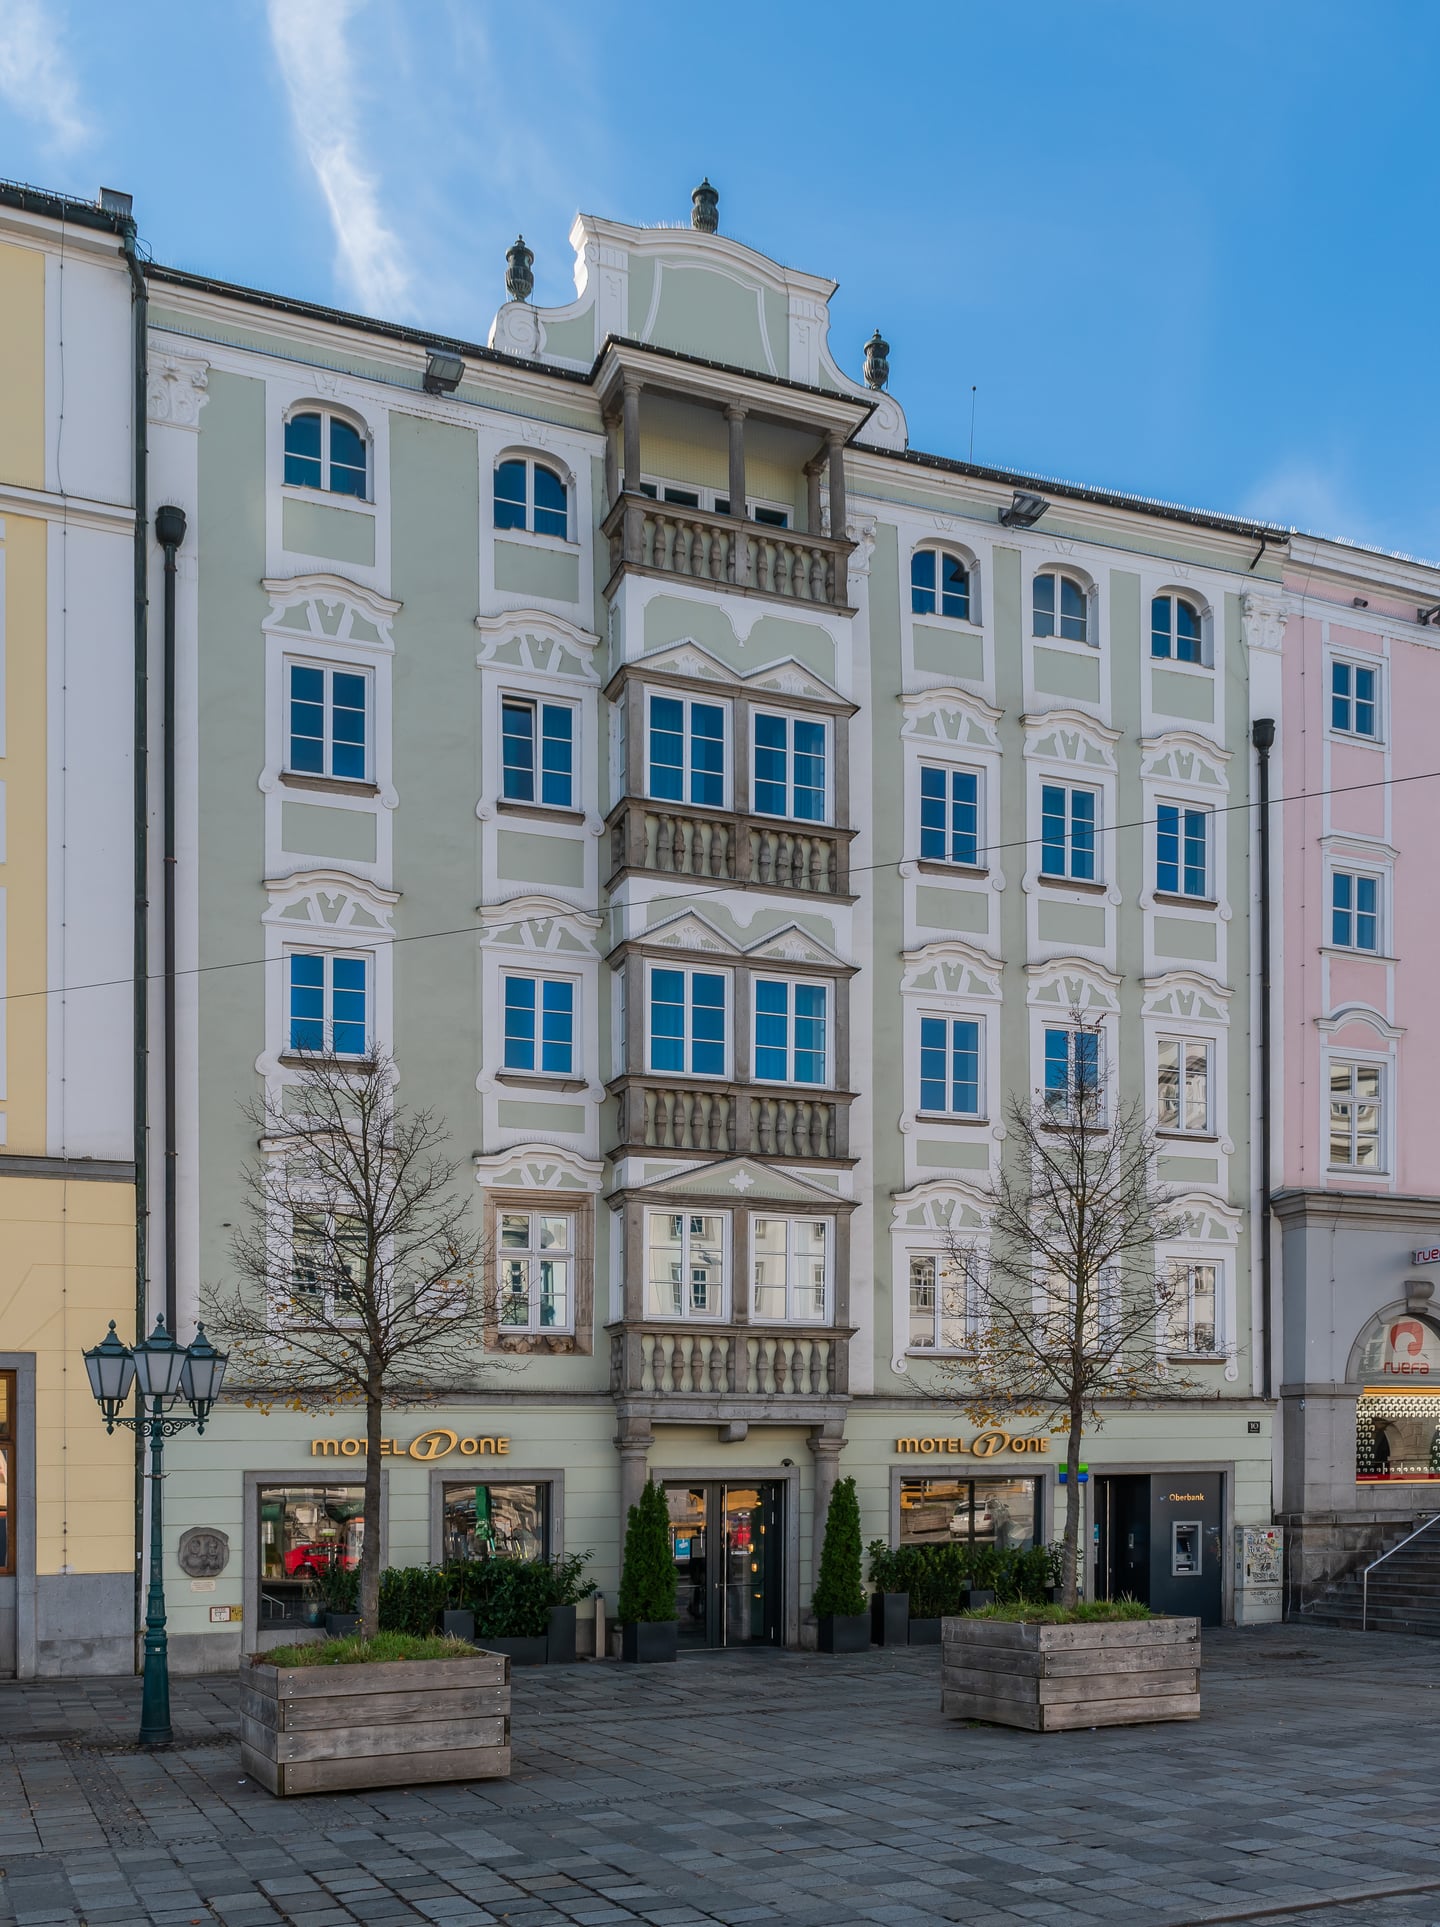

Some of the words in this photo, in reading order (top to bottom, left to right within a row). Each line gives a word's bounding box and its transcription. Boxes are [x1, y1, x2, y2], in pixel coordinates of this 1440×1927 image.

[1417, 1248, 1440, 1262] rue
[1384, 1361, 1430, 1374] ruefa
[460, 1437, 511, 1455] ONE
[896, 1437, 971, 1453] MOTEL
[1011, 1437, 1051, 1452] ONE
[1169, 1493, 1205, 1501] Oberbank
